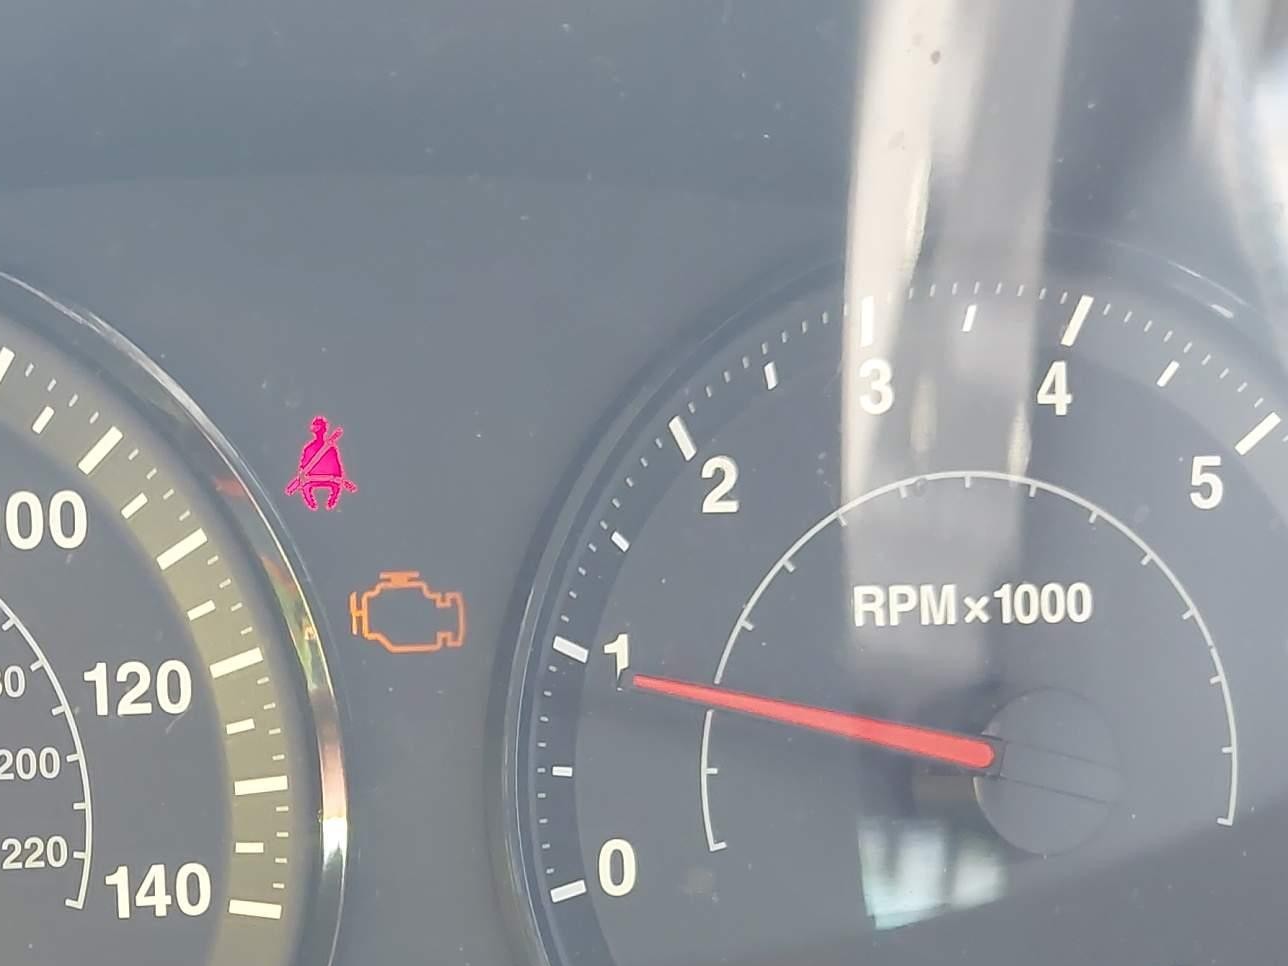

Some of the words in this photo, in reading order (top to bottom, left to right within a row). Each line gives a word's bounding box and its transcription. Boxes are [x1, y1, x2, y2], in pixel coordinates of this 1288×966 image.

[857, 358, 896, 414] 3
[1036, 360, 1073, 416] 4
[700, 455, 740, 514] 2
[1189, 455, 1224, 510] 5
[603, 633, 630, 681] 1
[83, 659, 193, 717] 120
[1, 837, 68, 870] 220
[597, 838, 637, 896] 0
[105, 862, 212, 919] 140
